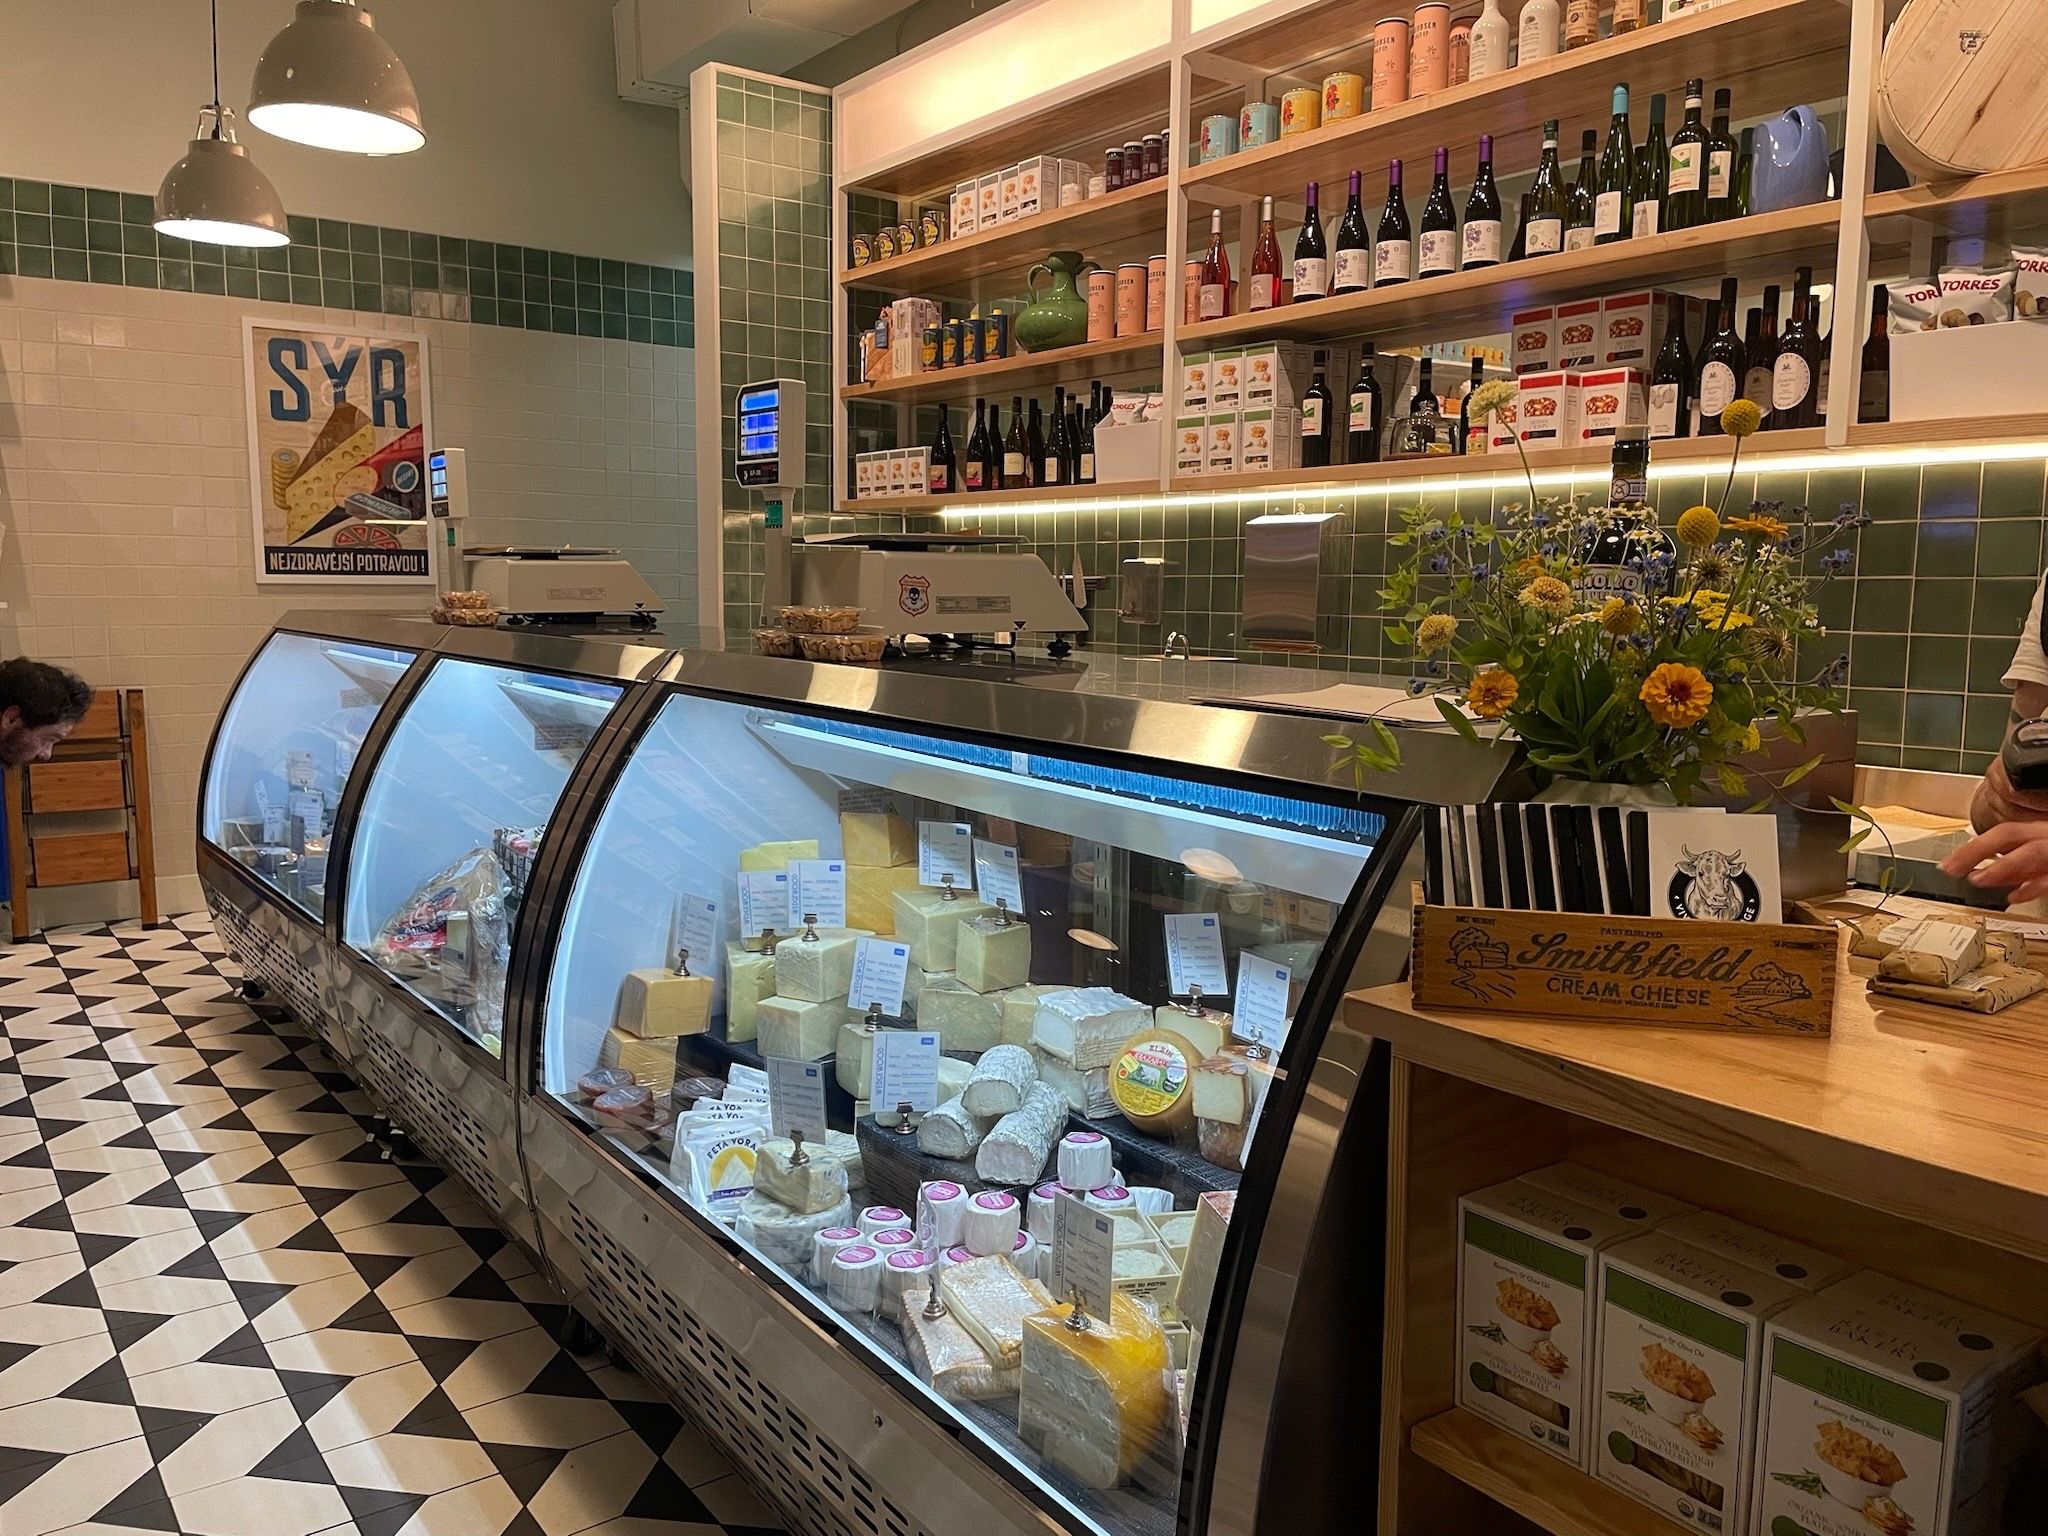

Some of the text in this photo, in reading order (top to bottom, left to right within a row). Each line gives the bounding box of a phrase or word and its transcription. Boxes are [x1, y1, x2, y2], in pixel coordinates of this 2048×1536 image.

[1943, 278, 2000, 292] TORRES
[267, 335, 411, 429] SÝR
[357, 554, 418, 572] POTRAVOU
[1600, 928, 1663, 938] PASTEURIZED
[1516, 932, 1753, 983] Smithfield
[1546, 977, 1712, 1006] CREAM CHEESE
[876, 1048, 884, 1096] WEDGEWOOD
[706, 1140, 729, 1159] FETA
